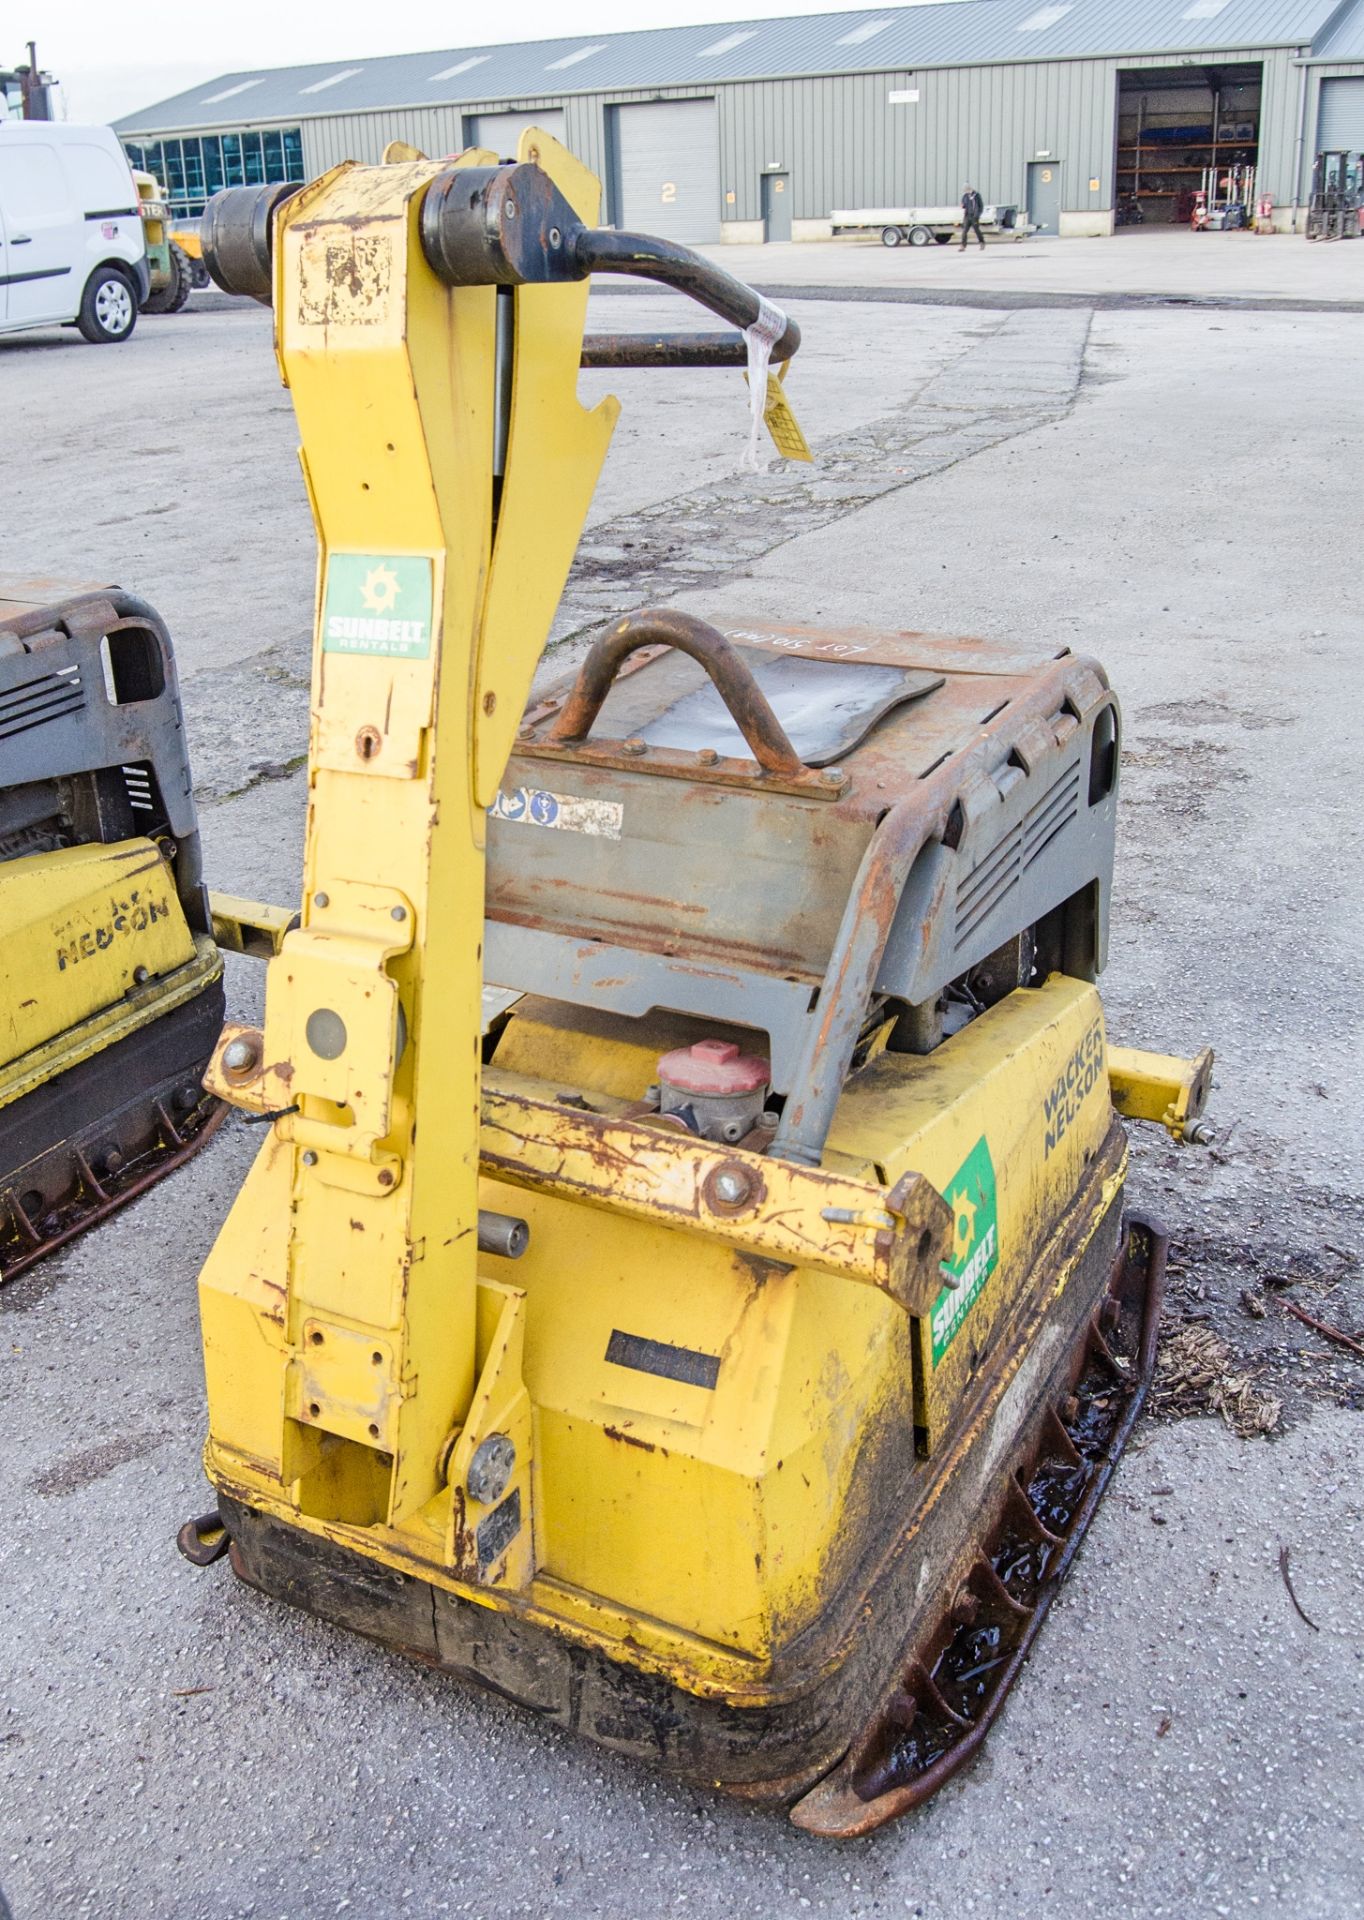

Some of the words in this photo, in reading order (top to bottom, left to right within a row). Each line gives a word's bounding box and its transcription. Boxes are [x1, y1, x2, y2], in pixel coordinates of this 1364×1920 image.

[775, 180, 785, 193] 2
[1041, 169, 1052, 183] 3
[661, 182, 676, 203] 2
[327, 615, 425, 643] SUNBELT
[338, 638, 409, 652] RENTALS
[56, 897, 169, 971] NEUSON
[932, 1223, 995, 1347] SUNBELT
